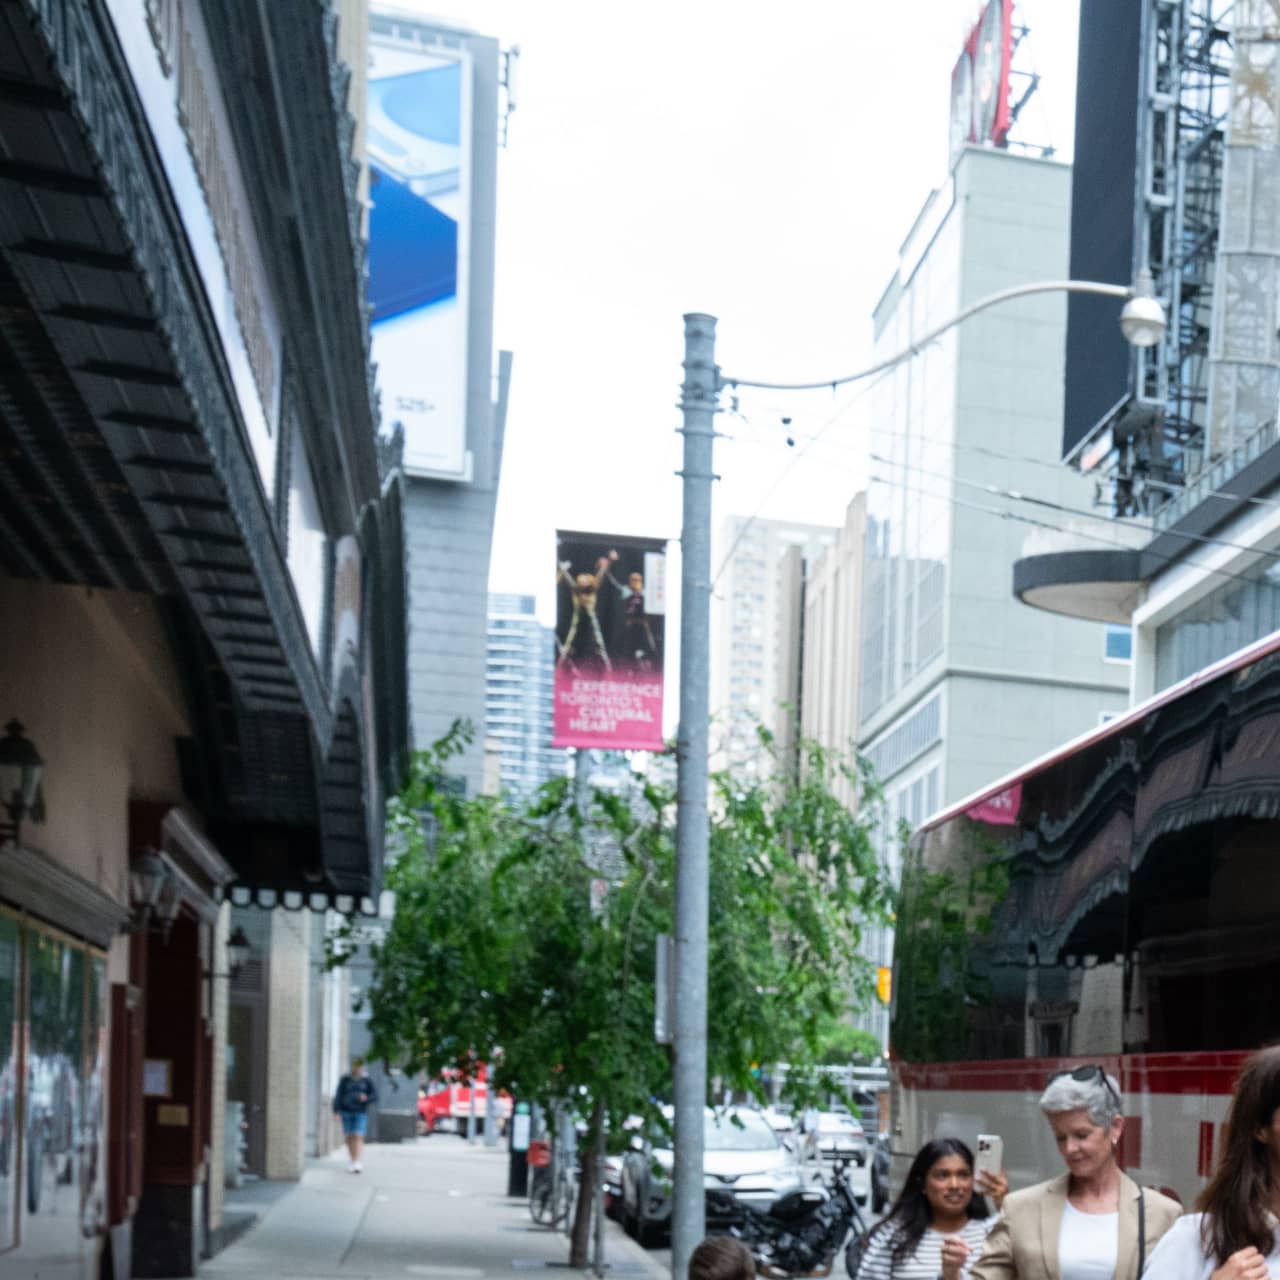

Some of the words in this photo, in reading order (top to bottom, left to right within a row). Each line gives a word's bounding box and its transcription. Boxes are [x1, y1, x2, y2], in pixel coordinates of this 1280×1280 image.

[572, 679, 660, 697] EXPERIENCE
[560, 691, 643, 708] TORONTO'S
[579, 705, 653, 722] CULTURAL
[569, 718, 617, 732] HEART
